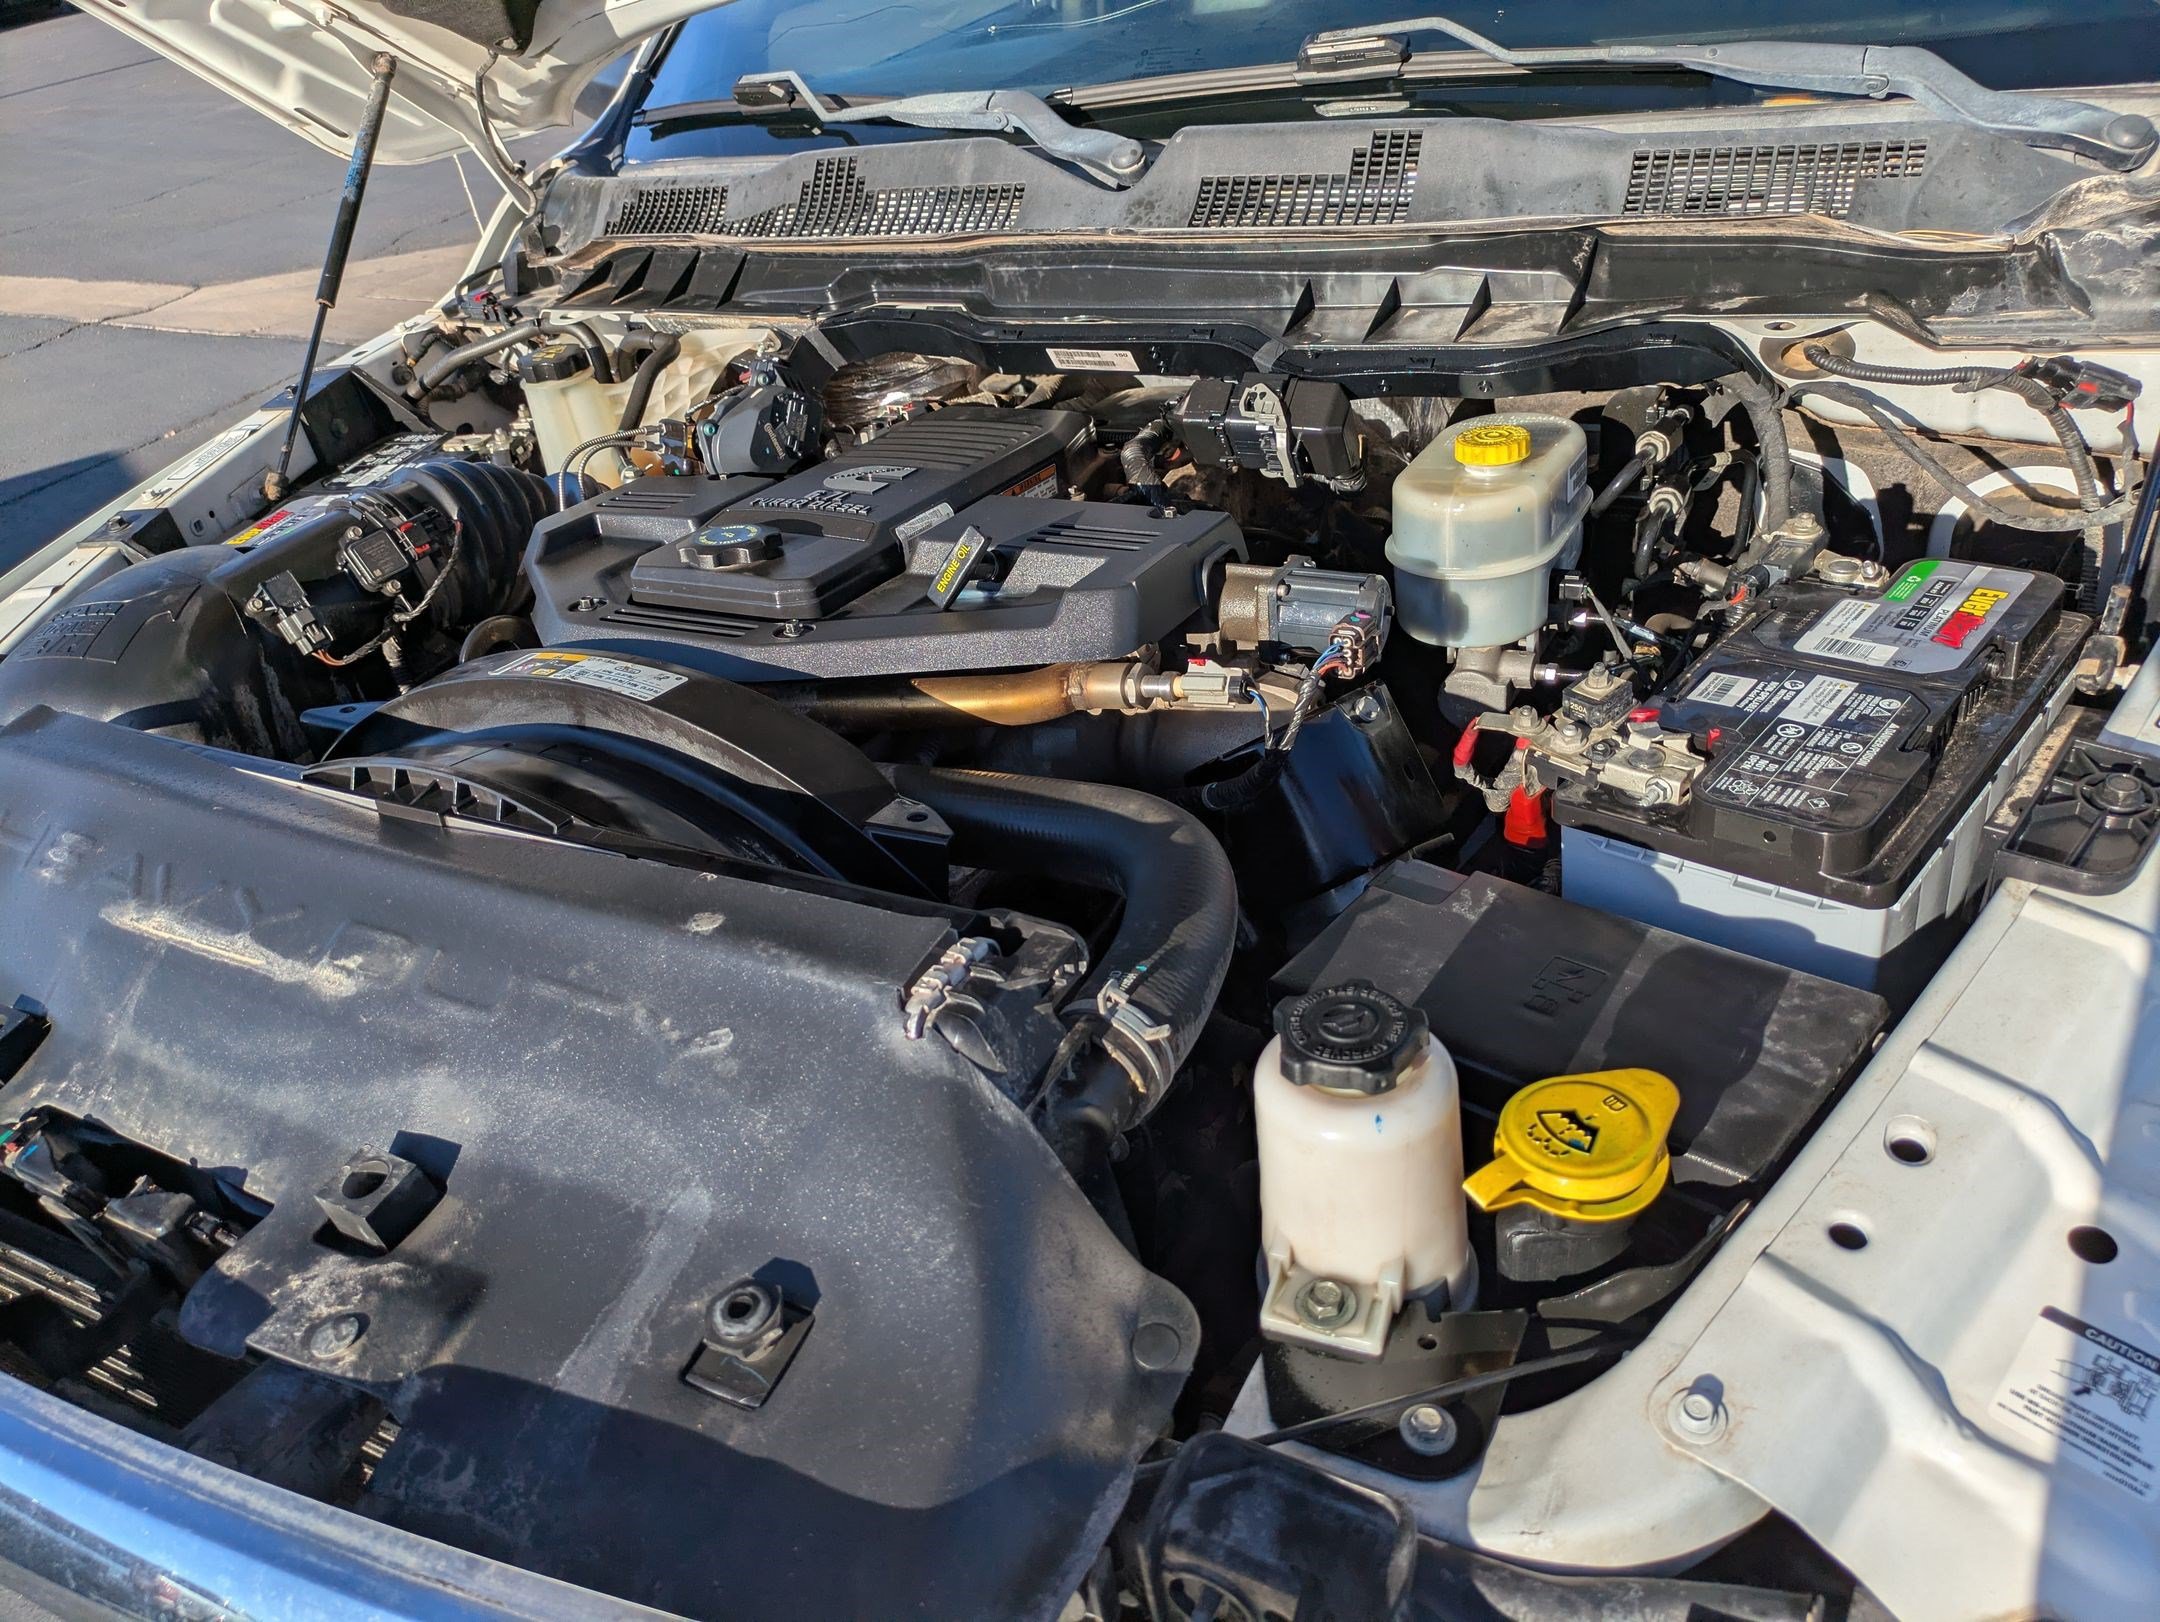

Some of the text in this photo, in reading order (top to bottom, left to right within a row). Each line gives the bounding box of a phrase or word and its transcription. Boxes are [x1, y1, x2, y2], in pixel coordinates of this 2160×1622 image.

[749, 497, 872, 516] TURBO DIESEL
[936, 543, 971, 594] ENGINE OIL
[1919, 608, 1950, 638] PLATINUM
[1751, 759, 1769, 771] NOT
[1763, 763, 1778, 772] DO
[2085, 1328, 2160, 1370] CAUTION
